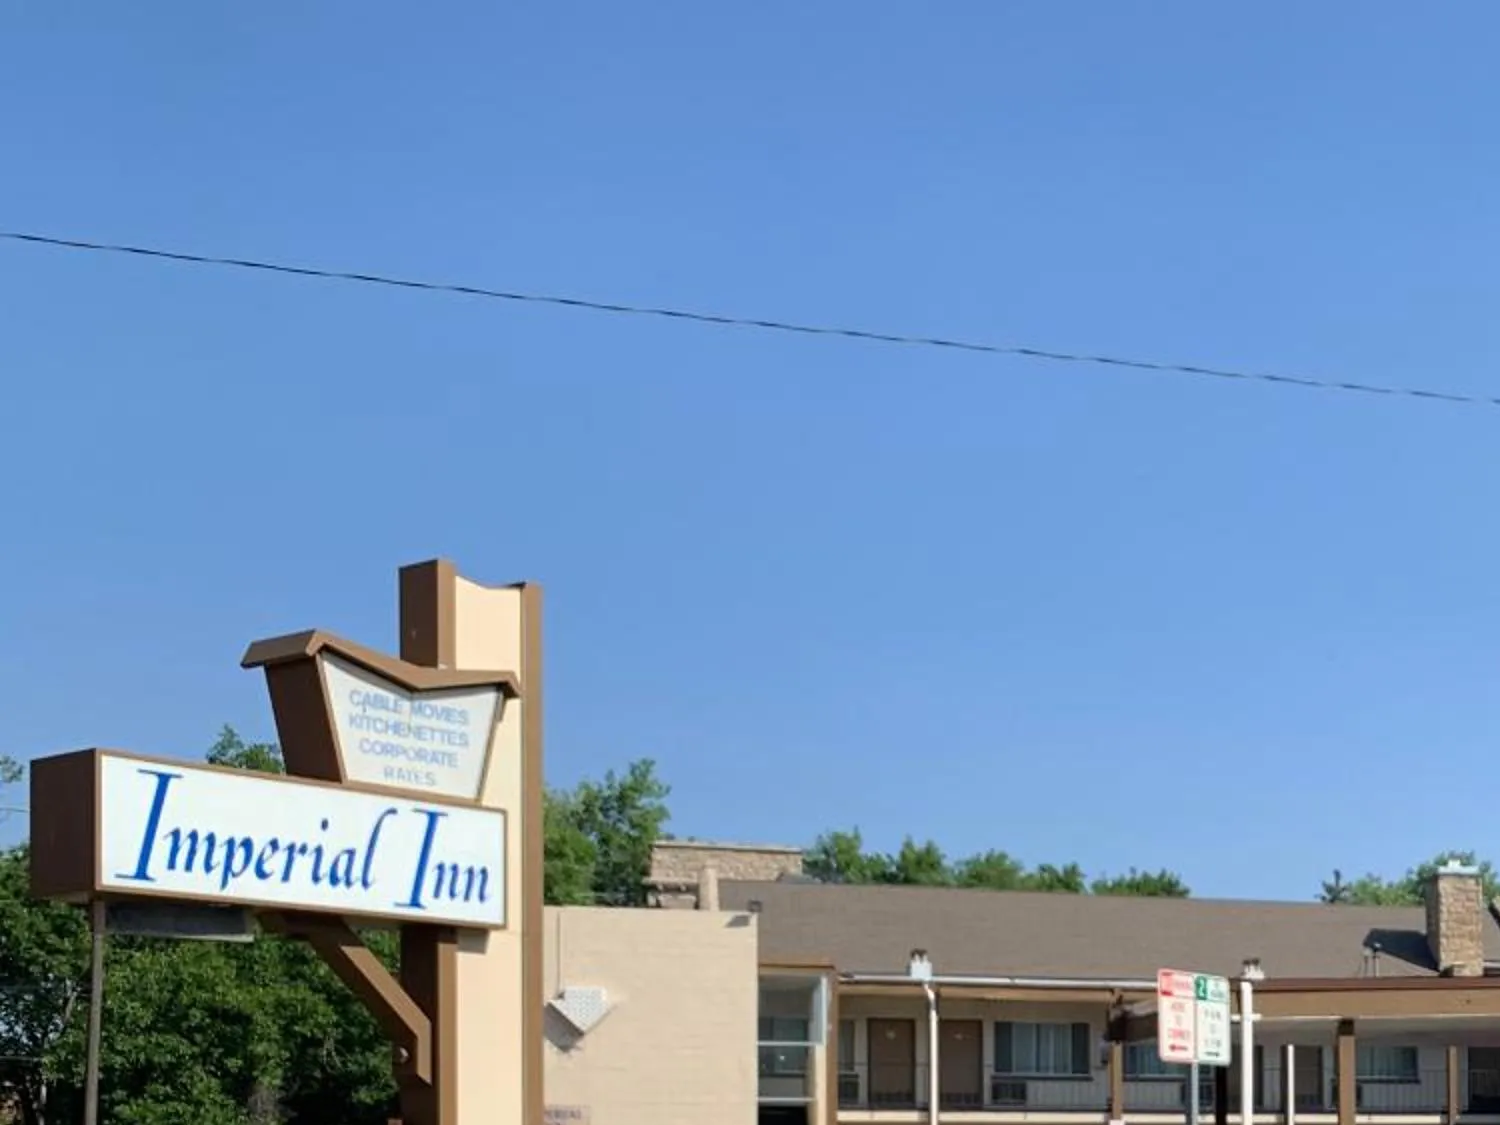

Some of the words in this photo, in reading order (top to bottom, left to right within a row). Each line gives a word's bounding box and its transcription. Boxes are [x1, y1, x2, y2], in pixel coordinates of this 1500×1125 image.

[349, 689, 403, 714] CABLE
[411, 700, 470, 726] MOVIES
[348, 712, 470, 748] KITCHENETTES
[359, 738, 459, 769] CORPORATE
[115, 769, 397, 891] Imperial
[394, 808, 489, 910] Inn
